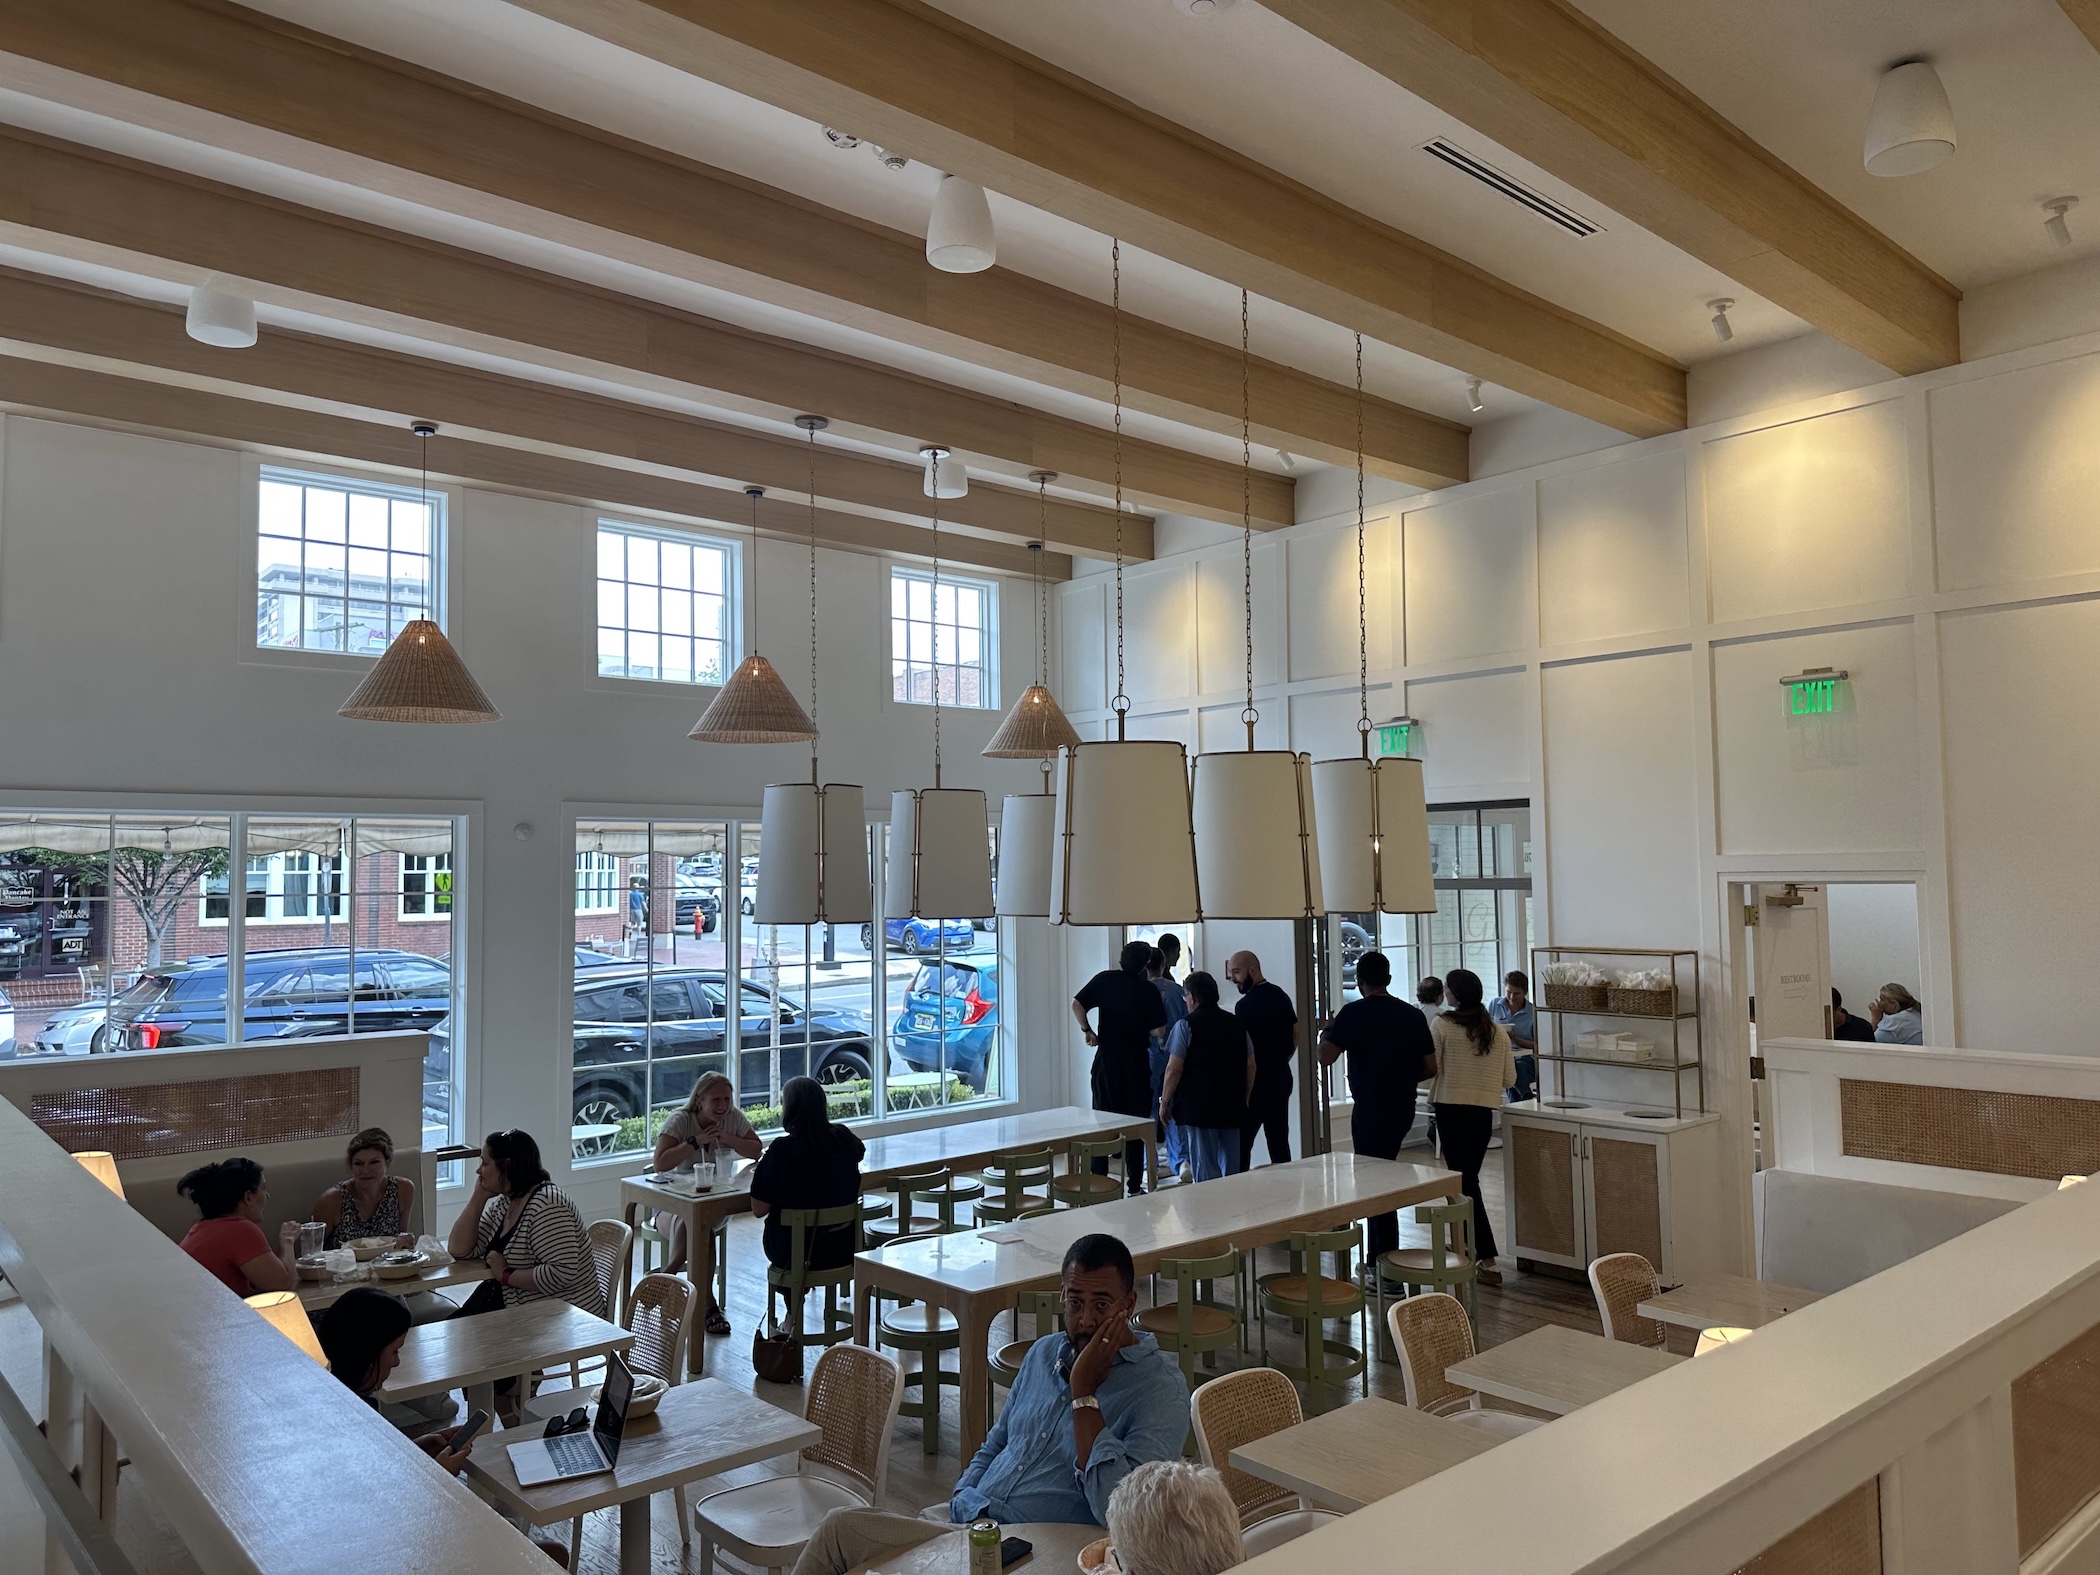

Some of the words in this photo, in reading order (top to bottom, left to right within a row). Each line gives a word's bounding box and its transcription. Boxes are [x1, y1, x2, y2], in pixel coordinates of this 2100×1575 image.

[1791, 681, 1835, 714] EXIT
[1381, 726, 1408, 754] EXIT
[63, 941, 83, 949] ADT
